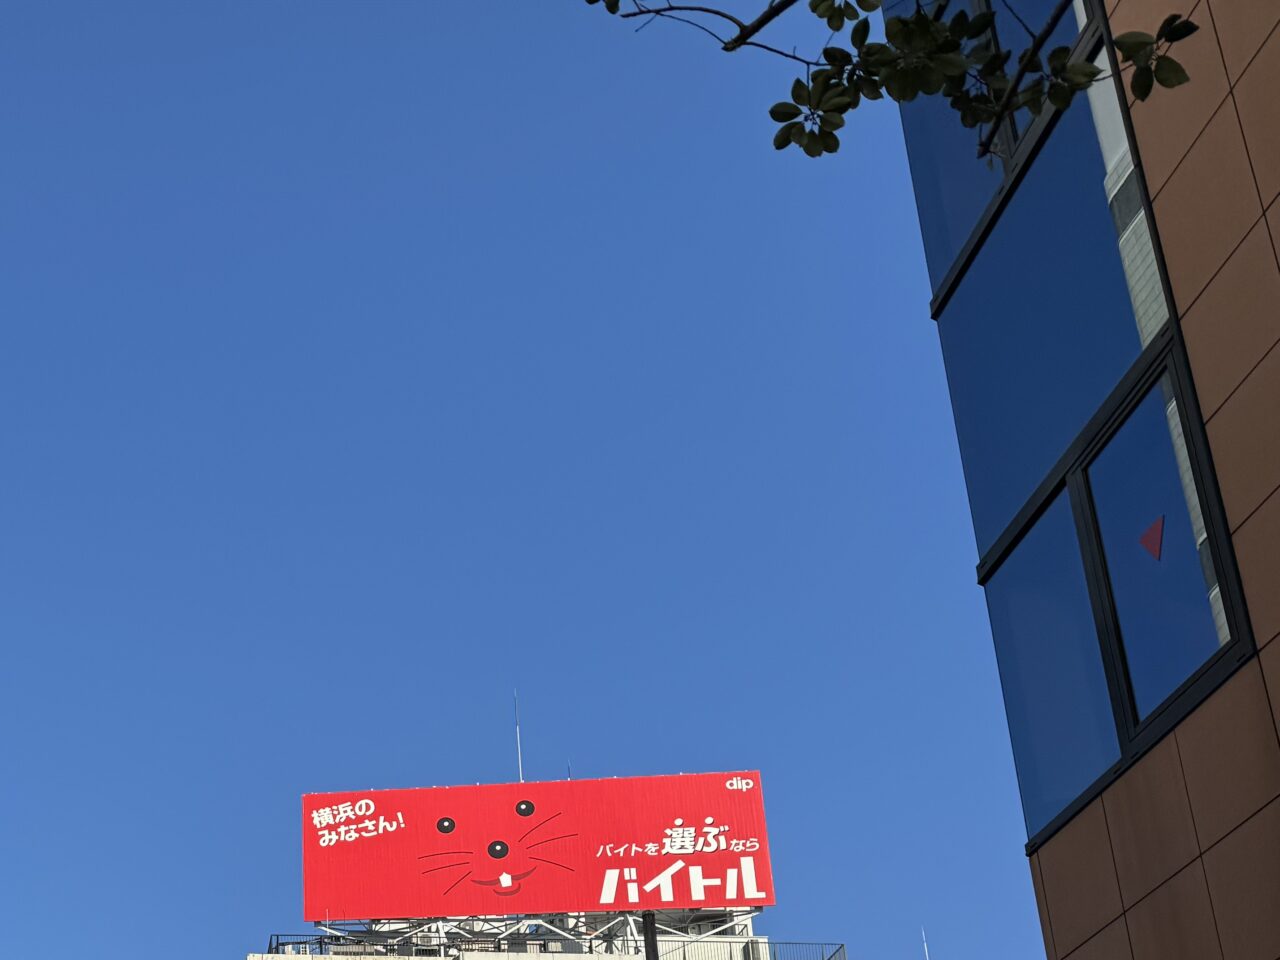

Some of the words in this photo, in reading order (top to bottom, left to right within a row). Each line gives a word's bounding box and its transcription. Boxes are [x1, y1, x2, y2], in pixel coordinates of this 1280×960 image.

[725, 776, 754, 792] dip
[311, 798, 376, 829] 横浜の
[317, 811, 406, 847] みなさん!
[595, 815, 760, 858] バイトを選ぶなら
[599, 855, 767, 905] バイトル
